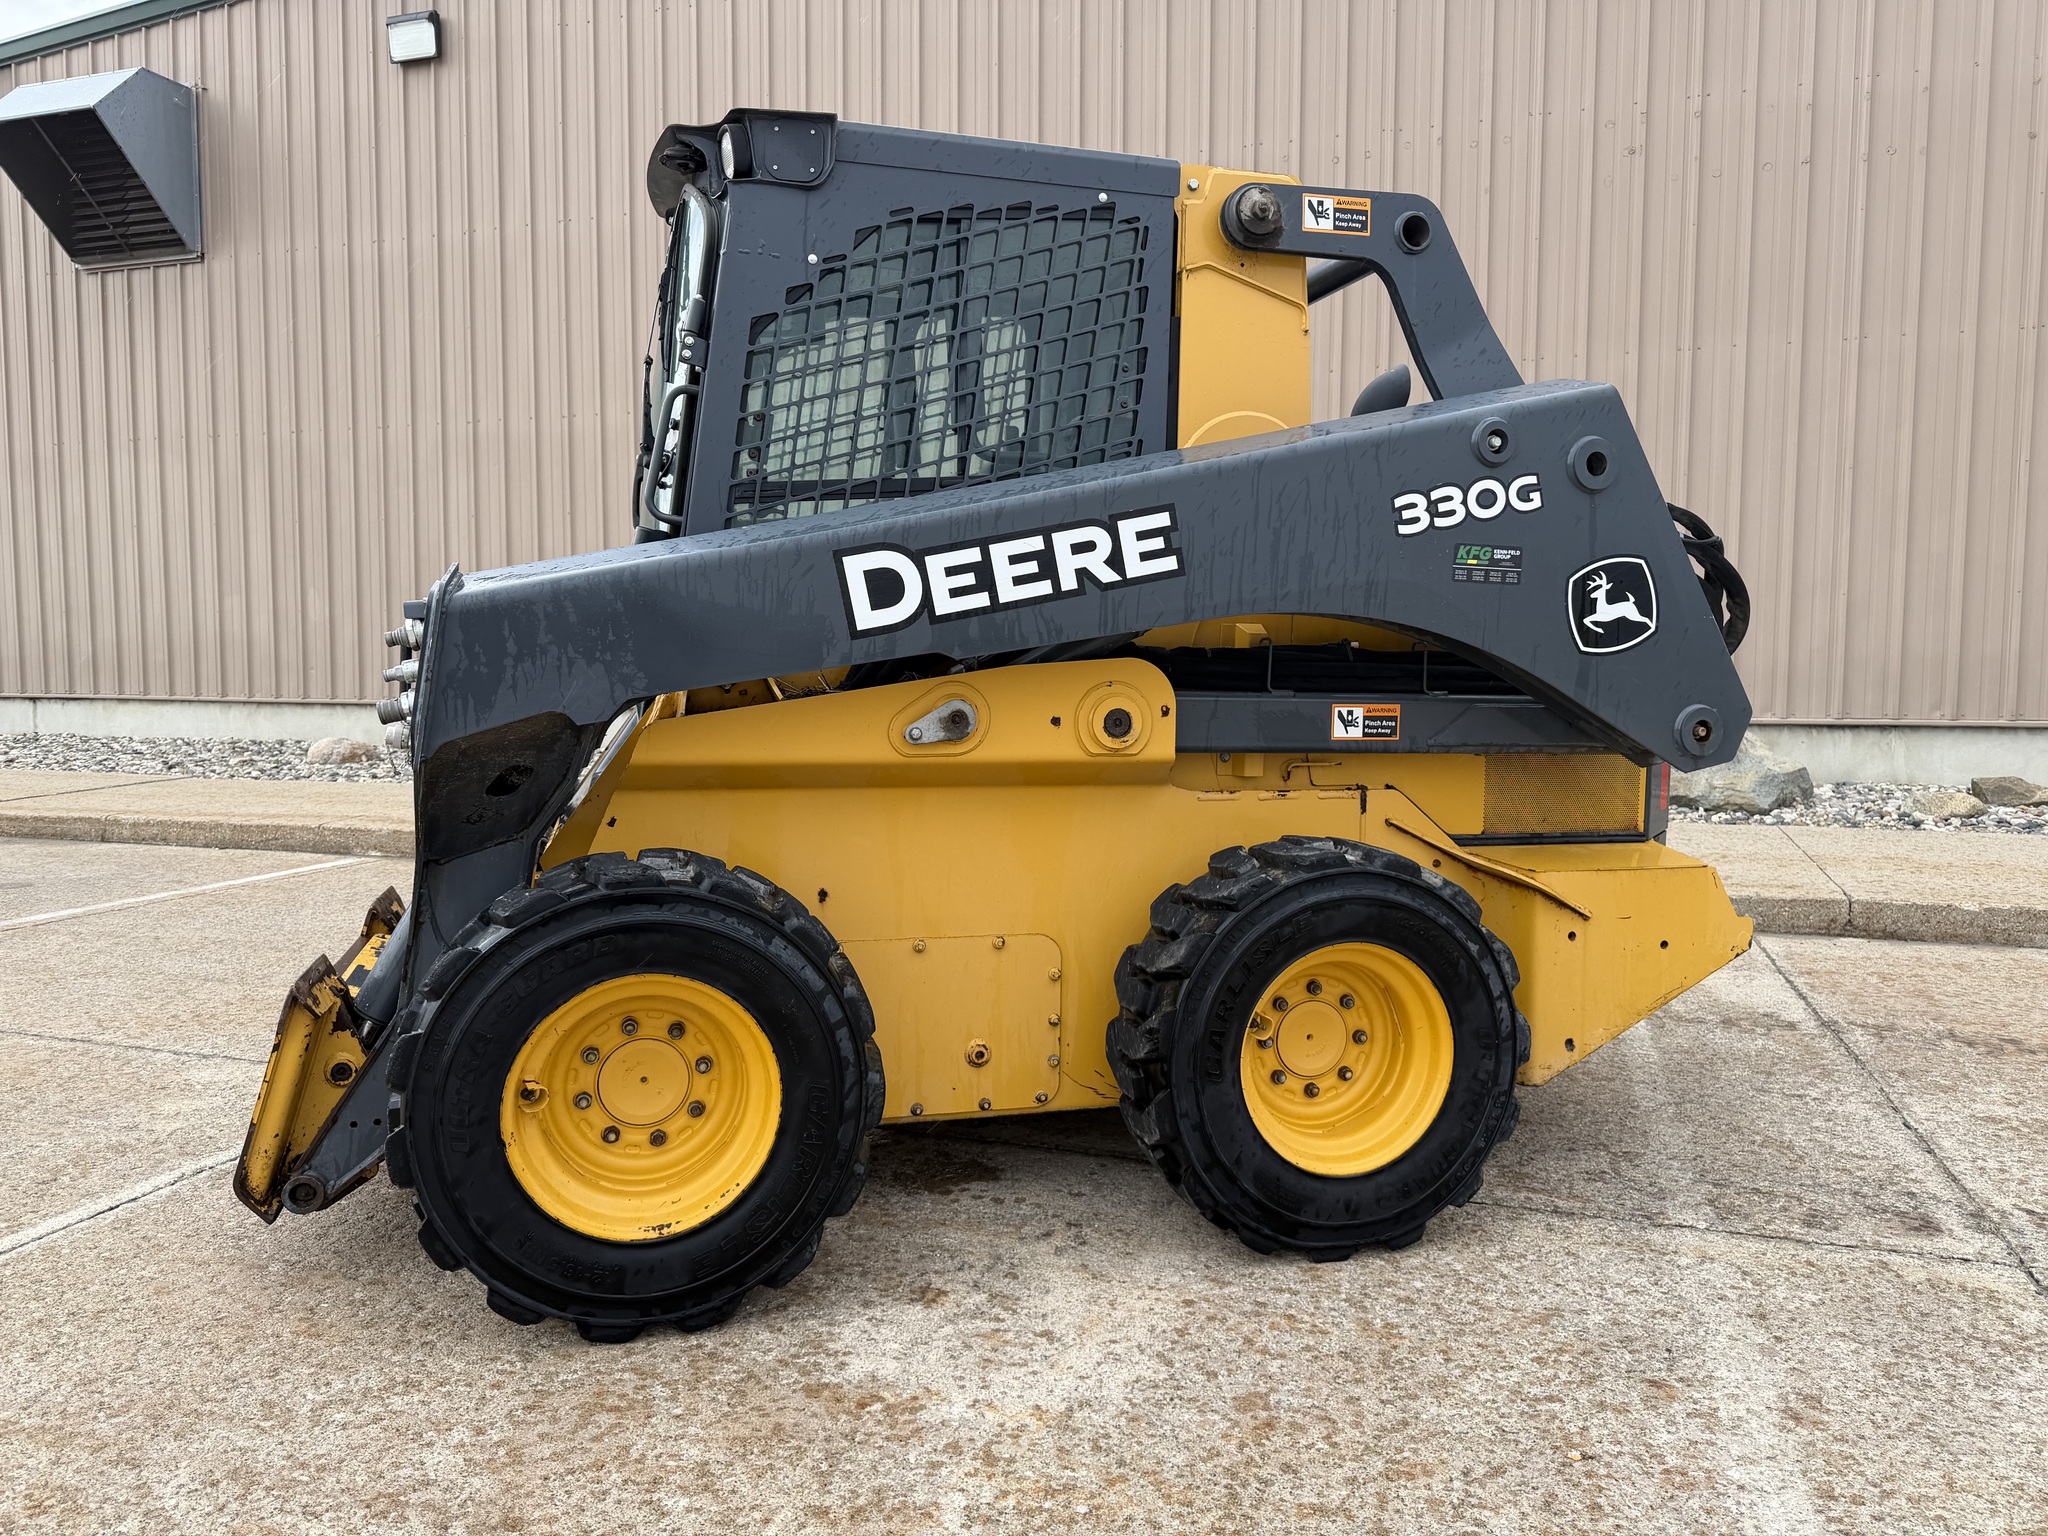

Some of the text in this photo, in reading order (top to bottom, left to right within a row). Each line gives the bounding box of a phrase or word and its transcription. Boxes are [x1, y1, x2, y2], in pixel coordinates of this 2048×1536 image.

[1335, 212, 1366, 221] Pinch Area
[1341, 199, 1368, 208] WARNING
[1335, 220, 1362, 229] Keep Away
[1393, 475, 1542, 535] 330G
[1457, 545, 1493, 560] KFG
[1493, 548, 1521, 556] KENN-FELD
[842, 511, 1179, 631] DEERE
[1364, 727, 1392, 735] Keep Away
[1206, 910, 1315, 1083] CARLISLE
[422, 989, 472, 1074] SEVERE
[449, 933, 618, 1154] ULTRA GUARD
[692, 1083, 831, 1279] CARLISLE
